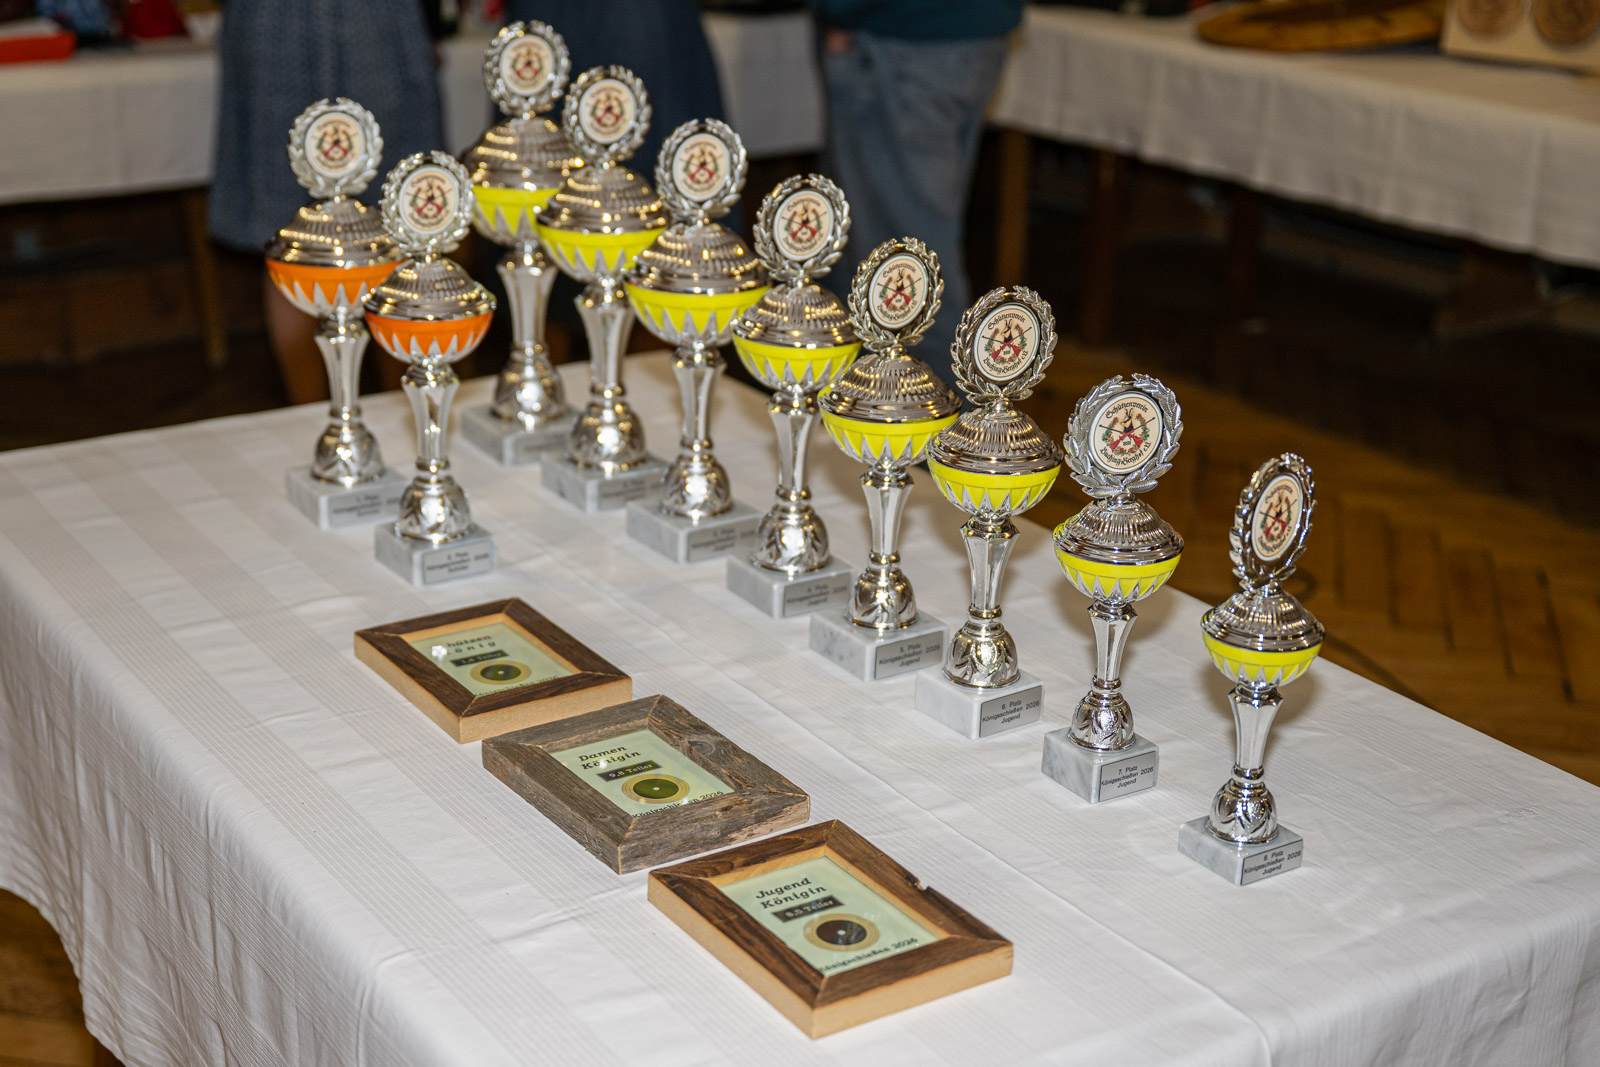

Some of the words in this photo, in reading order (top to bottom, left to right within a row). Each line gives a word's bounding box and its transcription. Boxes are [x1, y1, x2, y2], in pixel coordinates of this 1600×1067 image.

[1105, 401, 1149, 419] Schützenverein
[1009, 700, 1022, 708] Platz
[1025, 700, 1040, 710] 2026
[1001, 713, 1021, 724] Jugend
[578, 746, 627, 762] Damen
[625, 763, 653, 773] Teiler
[1125, 765, 1138, 773] Platz
[1140, 766, 1154, 776] 2026
[1117, 778, 1137, 788] Jugend
[1262, 864, 1283, 875] Jugend
[755, 876, 813, 900] Jugend
[759, 886, 828, 910] Königin
[803, 899, 834, 913] Teiler
[891, 937, 919, 949] 2026
